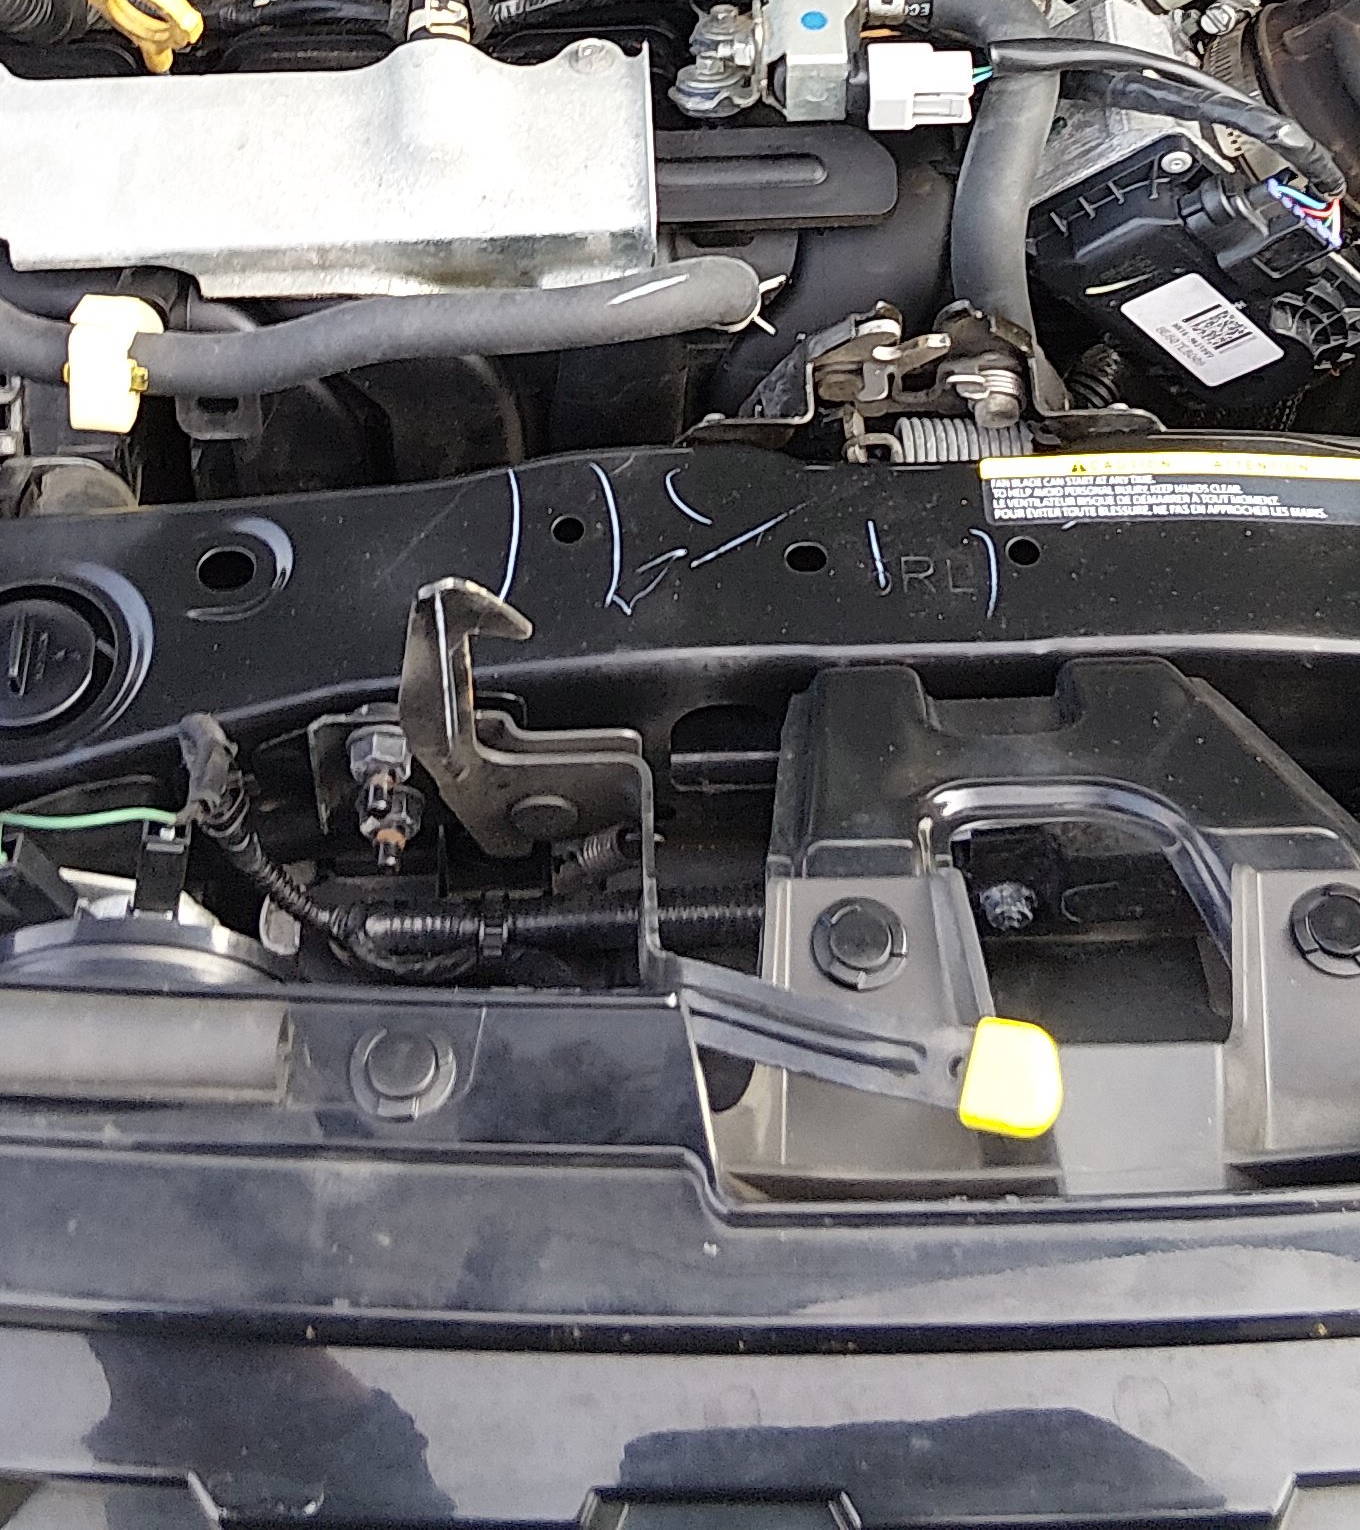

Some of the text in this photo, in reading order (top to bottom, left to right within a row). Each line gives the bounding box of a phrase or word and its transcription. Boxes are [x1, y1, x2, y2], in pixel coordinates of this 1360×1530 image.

[1042, 476, 1064, 486] CAN
[992, 488, 1007, 498] TO
[993, 498, 1006, 508] LE
